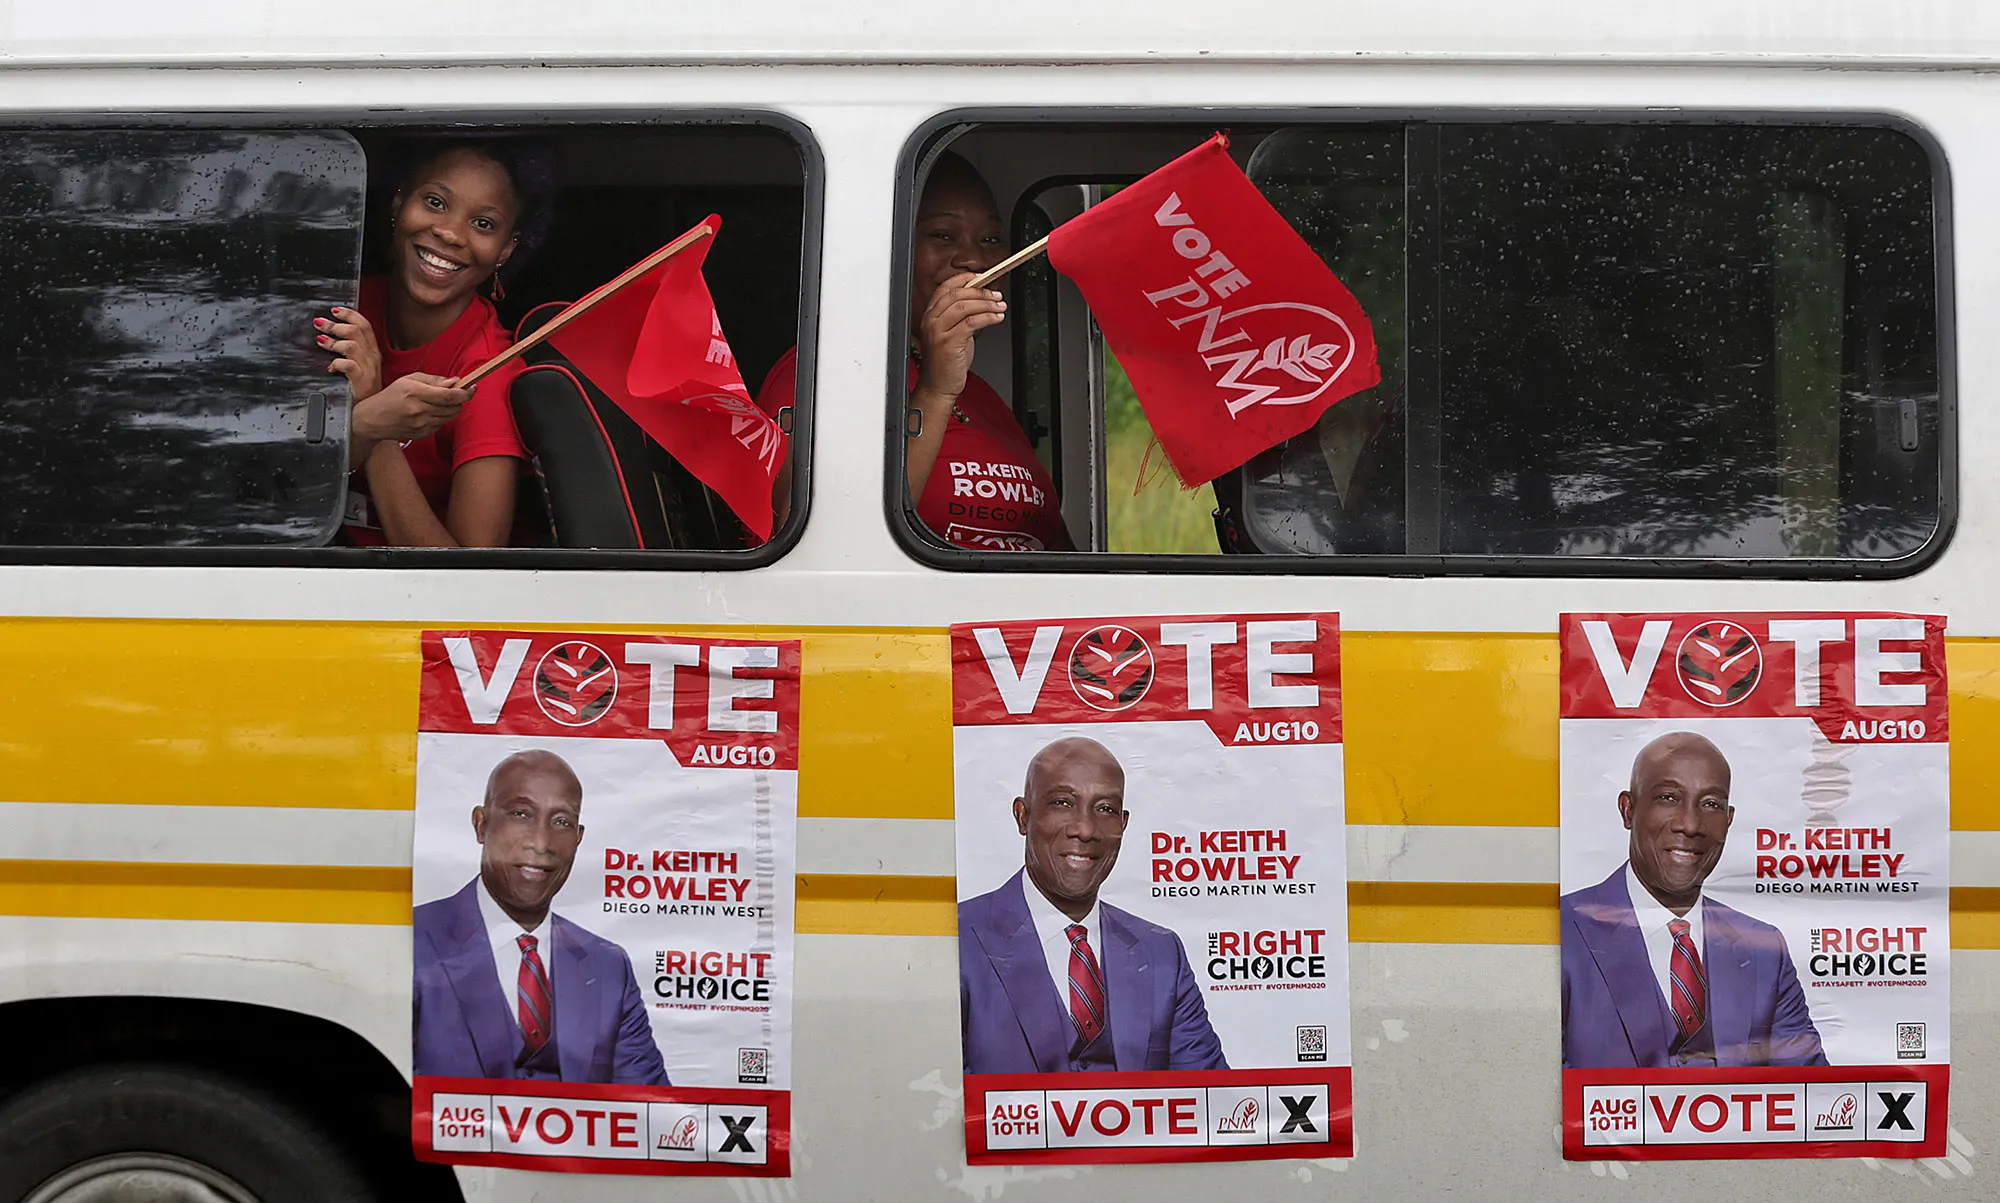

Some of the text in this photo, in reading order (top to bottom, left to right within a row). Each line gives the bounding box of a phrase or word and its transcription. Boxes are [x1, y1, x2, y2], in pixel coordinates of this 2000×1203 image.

[1154, 192, 1251, 299] VOTE
[1142, 275, 1280, 420] PNM
[953, 478, 1045, 508] ROWLEY
[948, 502, 1018, 523] DIEGO
[971, 620, 1320, 715] VOTE
[1581, 618, 1927, 708] VOTE
[442, 637, 779, 733] VOTE
[1233, 720, 1319, 743] AUG10
[1840, 719, 1925, 740] AUG10
[691, 744, 776, 766] AUG10
[1150, 829, 1287, 854] Dr. KEITH
[1755, 827, 1891, 851] Dr. KEITH
[603, 848, 738, 874] Dr. KEITH
[1150, 855, 1302, 883] ROWLEY
[1755, 853, 1906, 879] ROWLEY
[603, 875, 752, 902] ROWLEY
[1151, 883, 1316, 898] DIEGO MARTIN WEST
[1755, 881, 1919, 894] DIEGO MARTIN WEST
[602, 902, 765, 918] DIEGO MARTIN WEST
[1208, 932, 1218, 956] THE
[1219, 929, 1326, 956] RIGHT
[1810, 928, 1821, 953] THE
[1821, 926, 1928, 953] RIGHT
[655, 949, 665, 974] THE
[666, 950, 772, 978] RIGHT
[1207, 955, 1326, 980] CHOICE
[1808, 953, 1927, 978] CHOICE
[654, 976, 770, 1001] CHOICE
[1210, 982, 1326, 992] #STAYSAFETT #VOTEPNM2020
[1811, 979, 1927, 988] #STAYSAFETT #VOTEPNM2020
[439, 1107, 485, 1122] AUG
[991, 1104, 1039, 1121] AUG
[1051, 1097, 1198, 1138] VOTE
[1278, 1095, 1318, 1133] X
[1589, 1099, 1637, 1115] AUG
[1649, 1093, 1796, 1134] VOTE
[1816, 1113, 1854, 1126] PNM
[1876, 1091, 1915, 1131] X
[439, 1123, 485, 1139] 10TH
[497, 1104, 639, 1148] VOTE
[718, 1115, 756, 1153] X
[992, 1121, 1039, 1136] 10TH
[1218, 1117, 1256, 1130] PNM
[1589, 1116, 1637, 1131] 10TH
[657, 1133, 695, 1148] PNM
